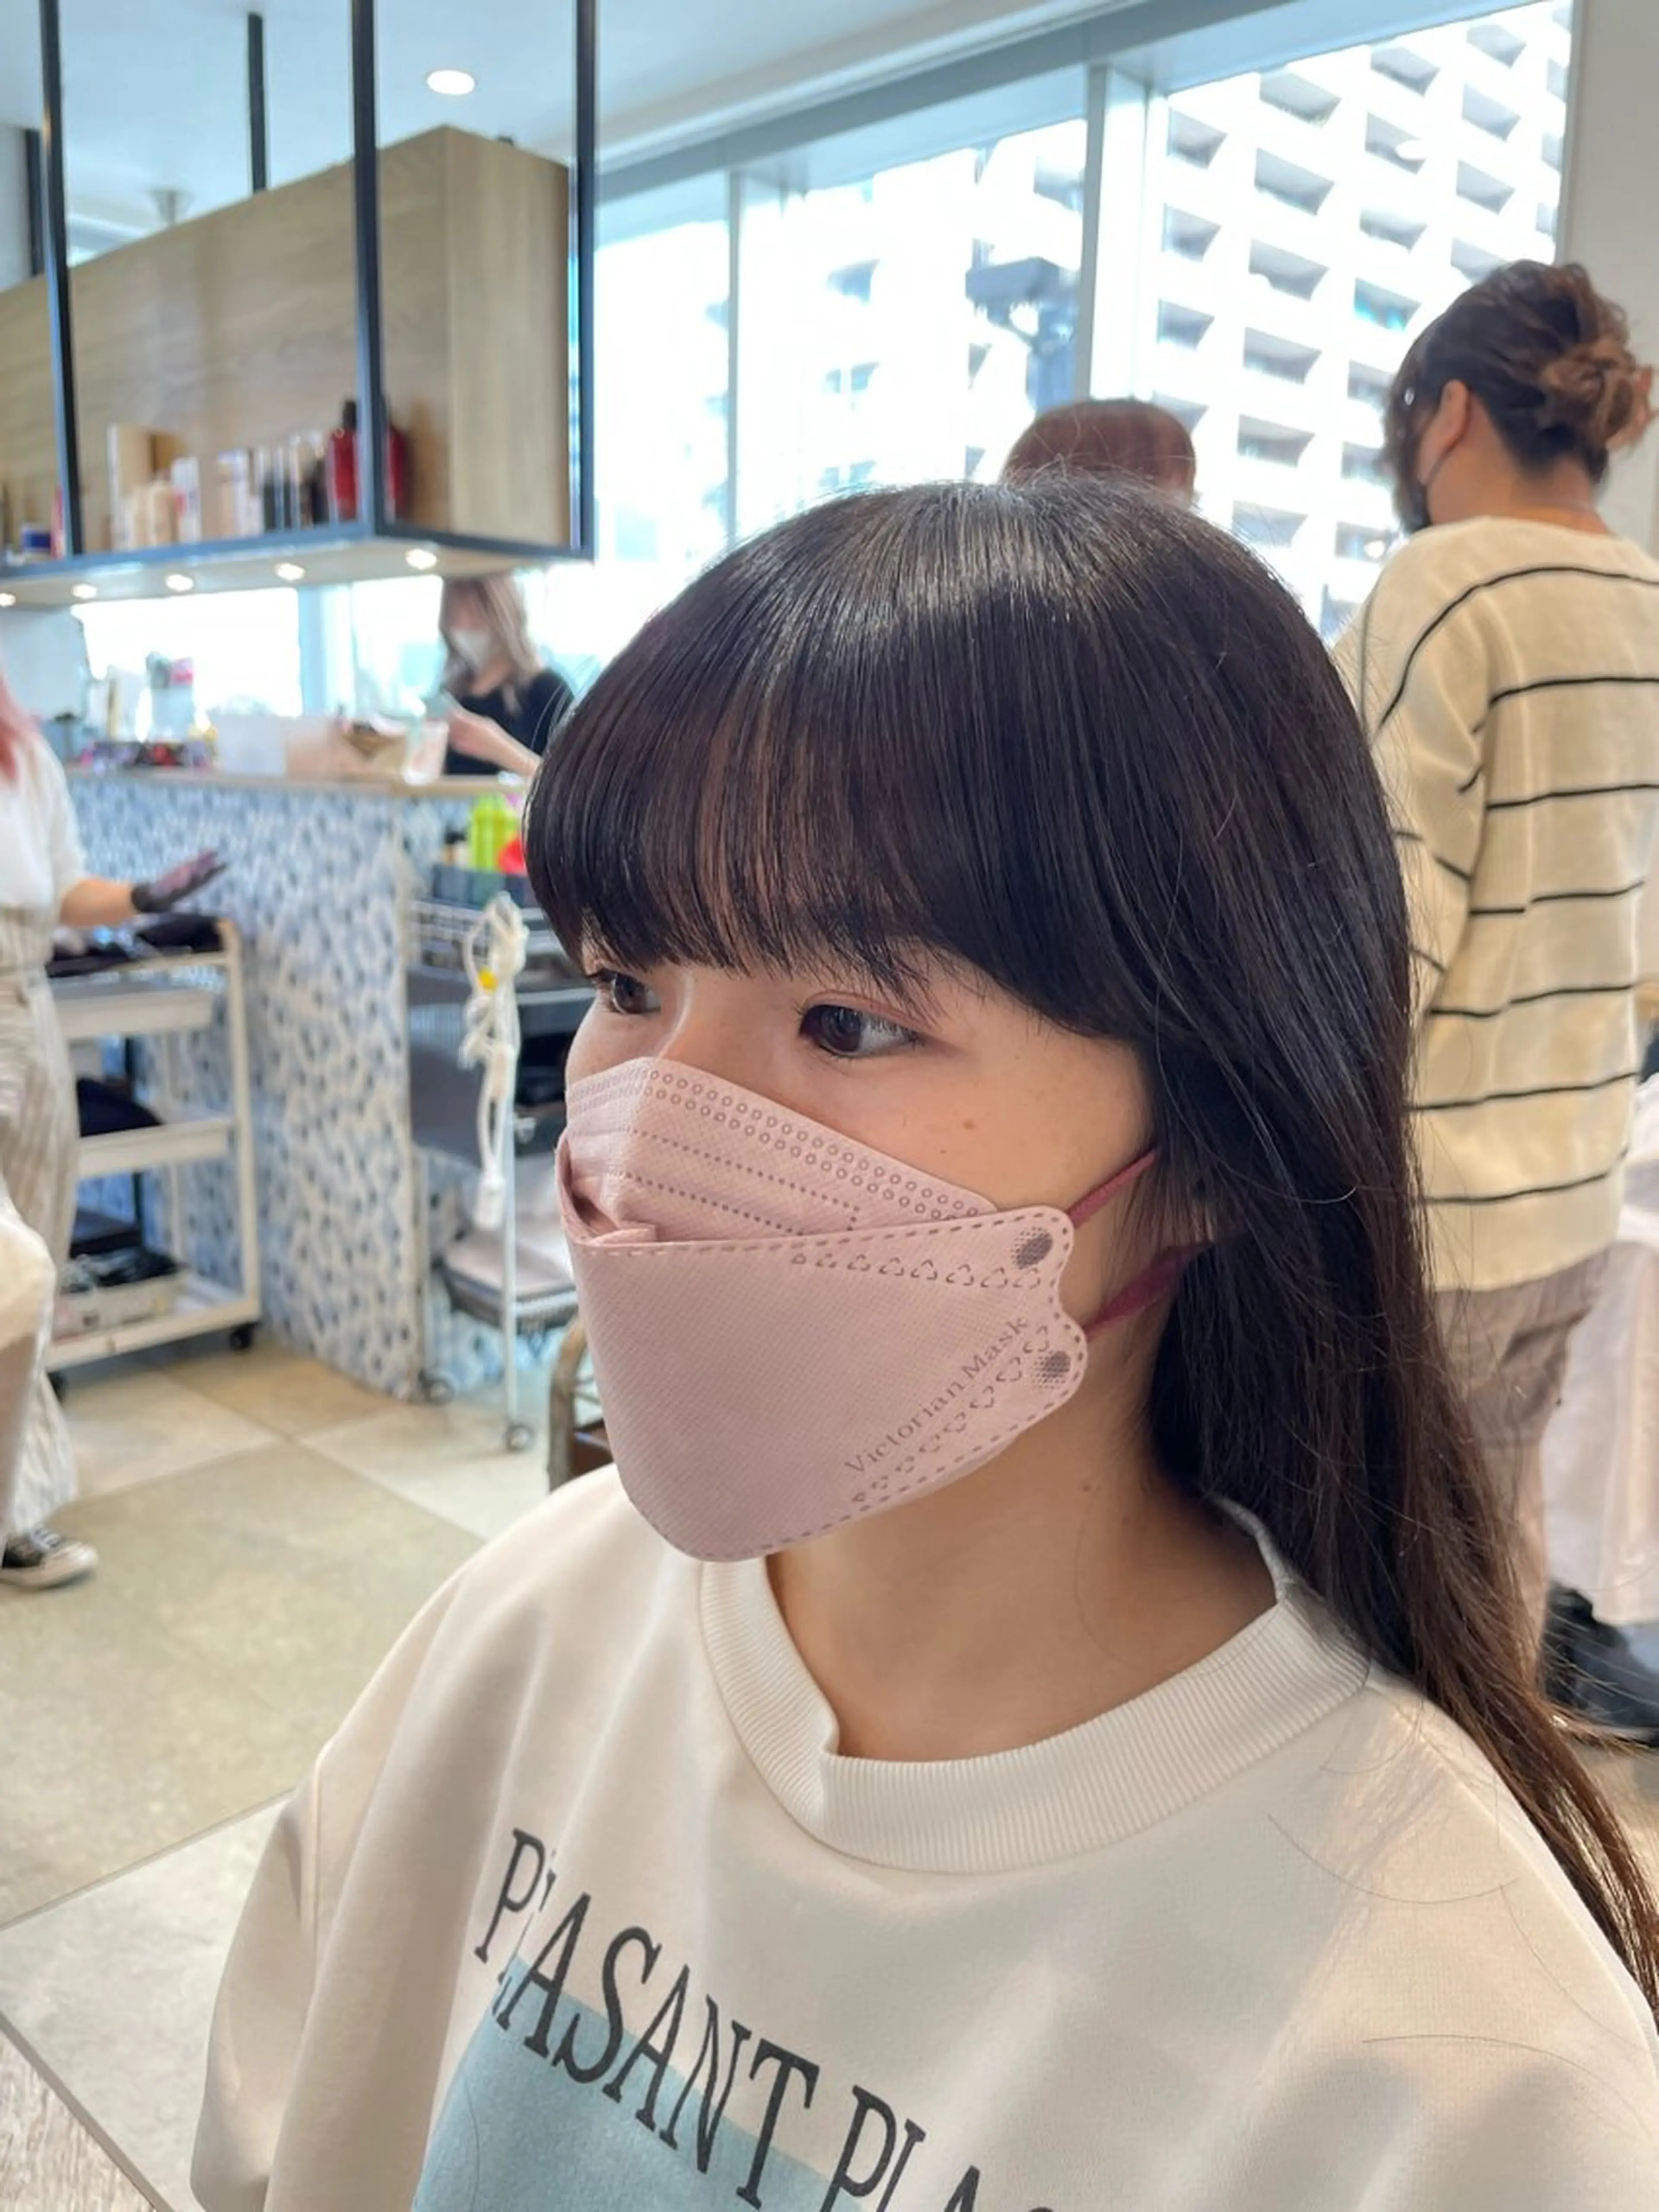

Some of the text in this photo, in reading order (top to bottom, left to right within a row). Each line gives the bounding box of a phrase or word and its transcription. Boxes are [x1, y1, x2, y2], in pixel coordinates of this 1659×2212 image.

[845, 1318, 1028, 1472] Victorian Mask
[474, 1828, 820, 2209] PASANT
